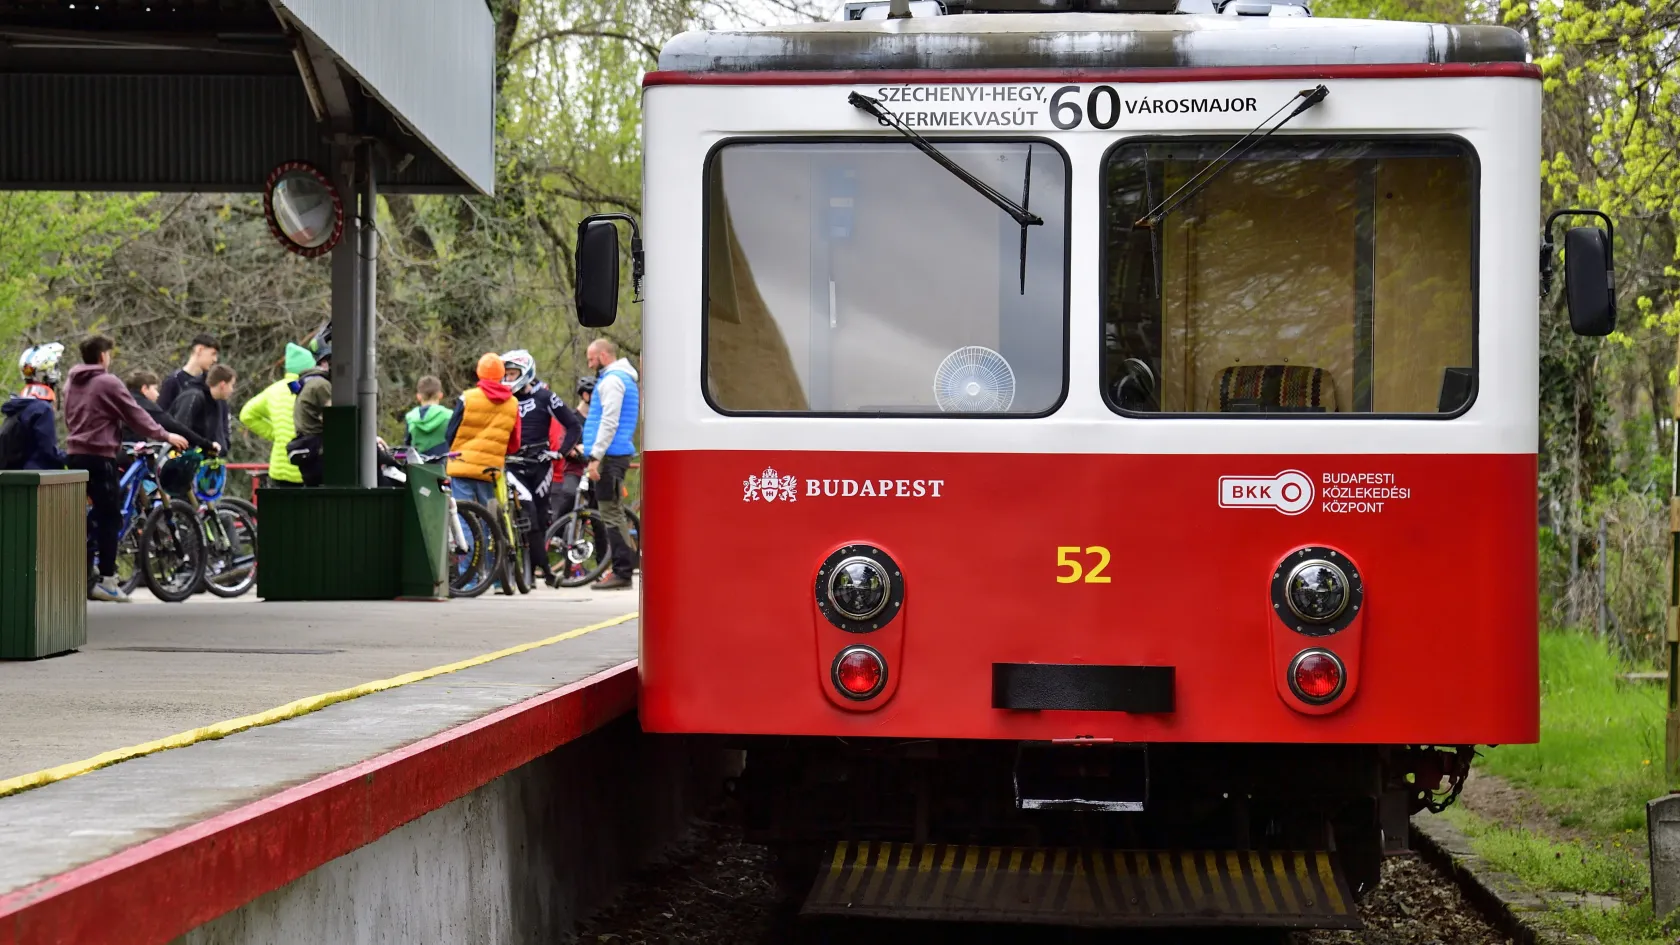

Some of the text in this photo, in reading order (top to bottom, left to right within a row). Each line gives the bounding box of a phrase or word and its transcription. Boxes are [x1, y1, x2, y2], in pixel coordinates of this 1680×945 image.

[878, 84, 1047, 104] SZÉCHENYI-HEGY,
[1049, 85, 1121, 130] 60
[1125, 97, 1257, 114] VÁROSMAJOR
[1322, 473, 1394, 484] BUDAPESTI
[806, 479, 944, 497] BUDAPEST
[1232, 485, 1272, 498] BKK
[1322, 485, 1411, 498] KÖZLEKEDÉSI
[1322, 500, 1384, 513] KÖZPONT
[1056, 545, 1112, 584] 52
